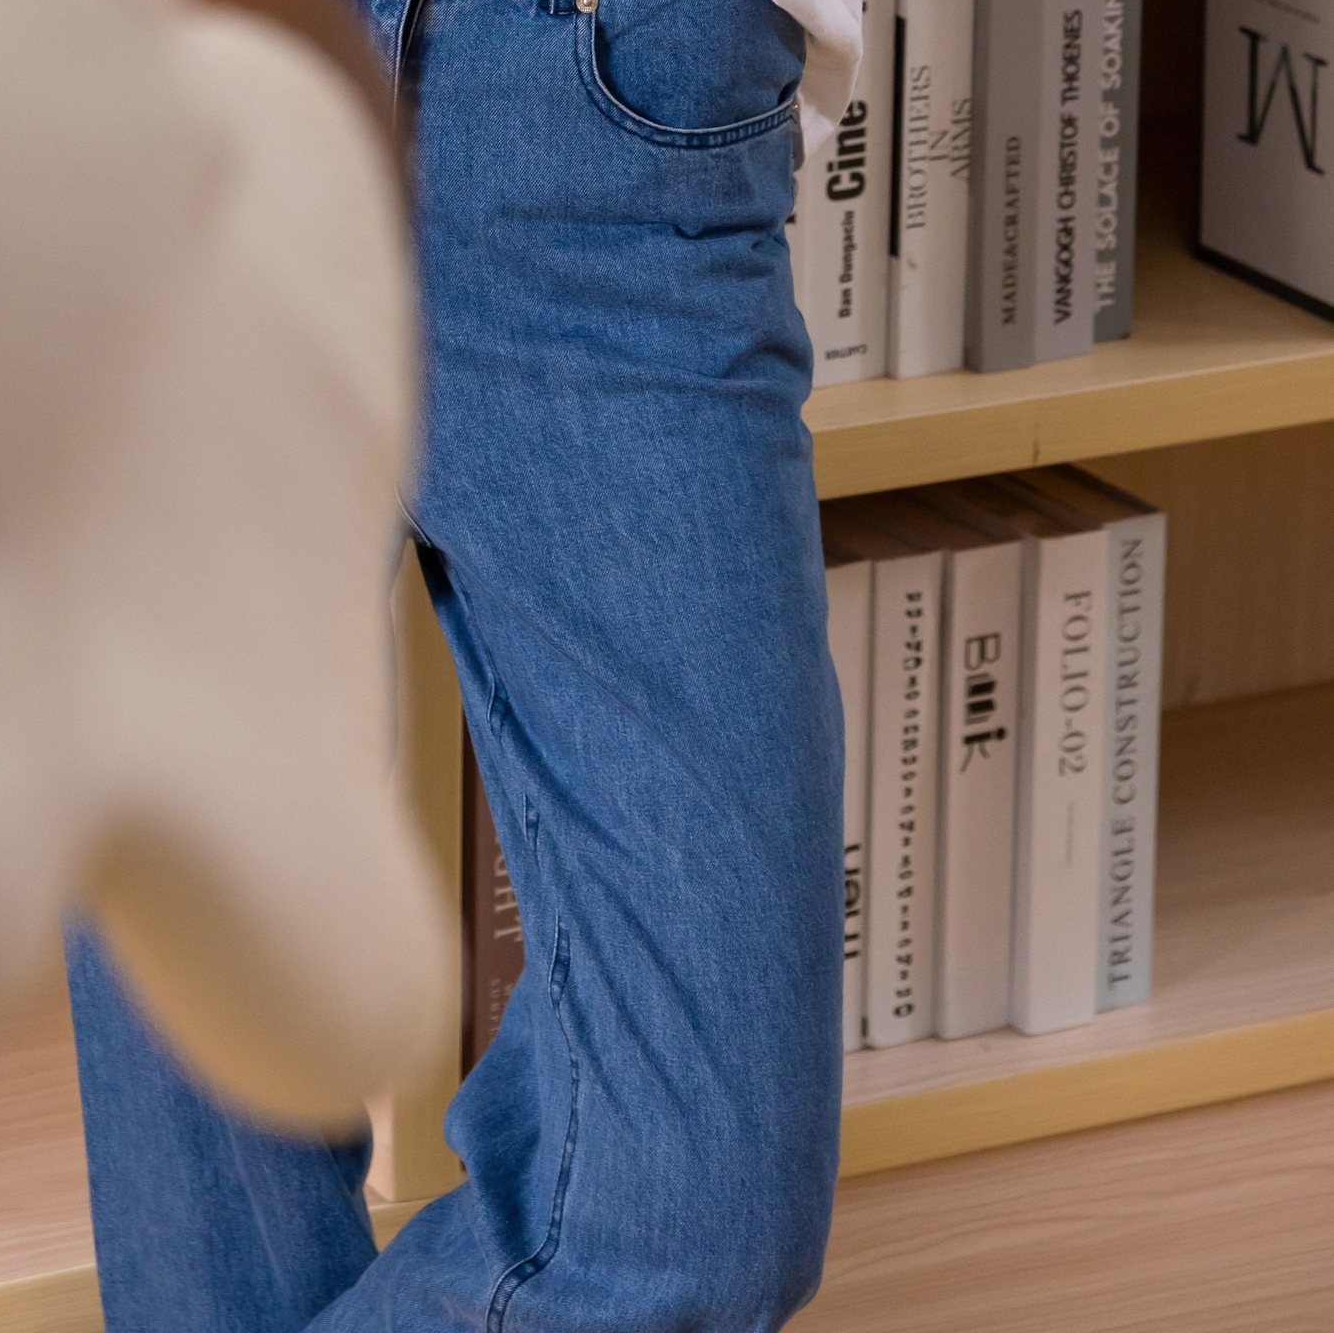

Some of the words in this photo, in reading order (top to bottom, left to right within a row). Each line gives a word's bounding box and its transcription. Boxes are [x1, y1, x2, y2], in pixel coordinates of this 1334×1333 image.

[827, 101, 867, 201] Cine
[839, 272, 853, 318] Dan
[1059, 590, 1092, 775] FOLIO-02
[1113, 536, 1144, 805] CONSTRUCTION
[1108, 818, 1135, 986] TRIANGLE
